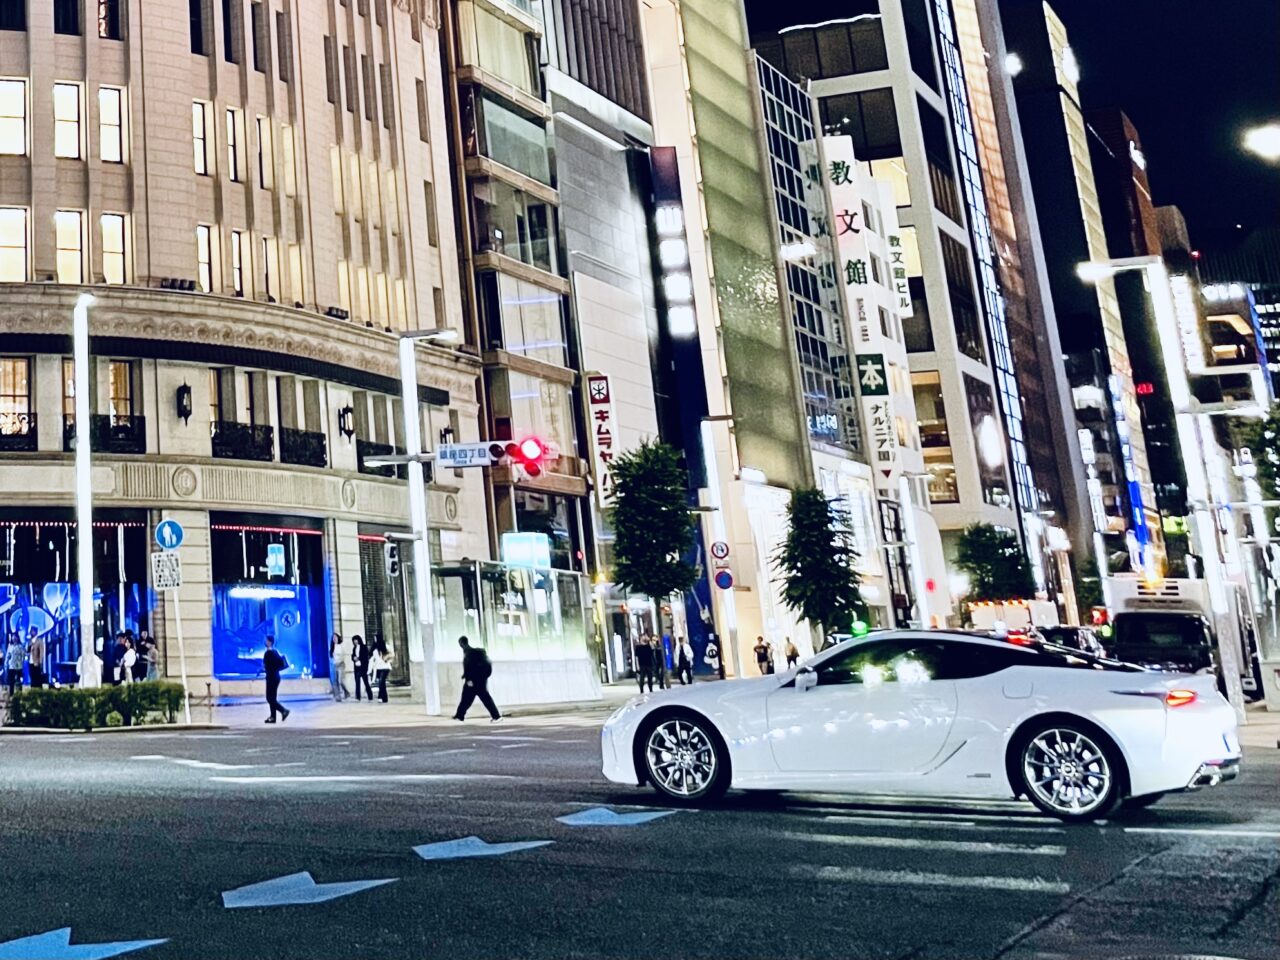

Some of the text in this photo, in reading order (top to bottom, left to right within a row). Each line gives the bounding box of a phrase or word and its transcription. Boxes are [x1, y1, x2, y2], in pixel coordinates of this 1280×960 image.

[829, 160, 869, 285] 教文館
[888, 235, 911, 308] 教文館ビル
[859, 359, 884, 391] 本
[870, 404, 891, 461] ナルニア国
